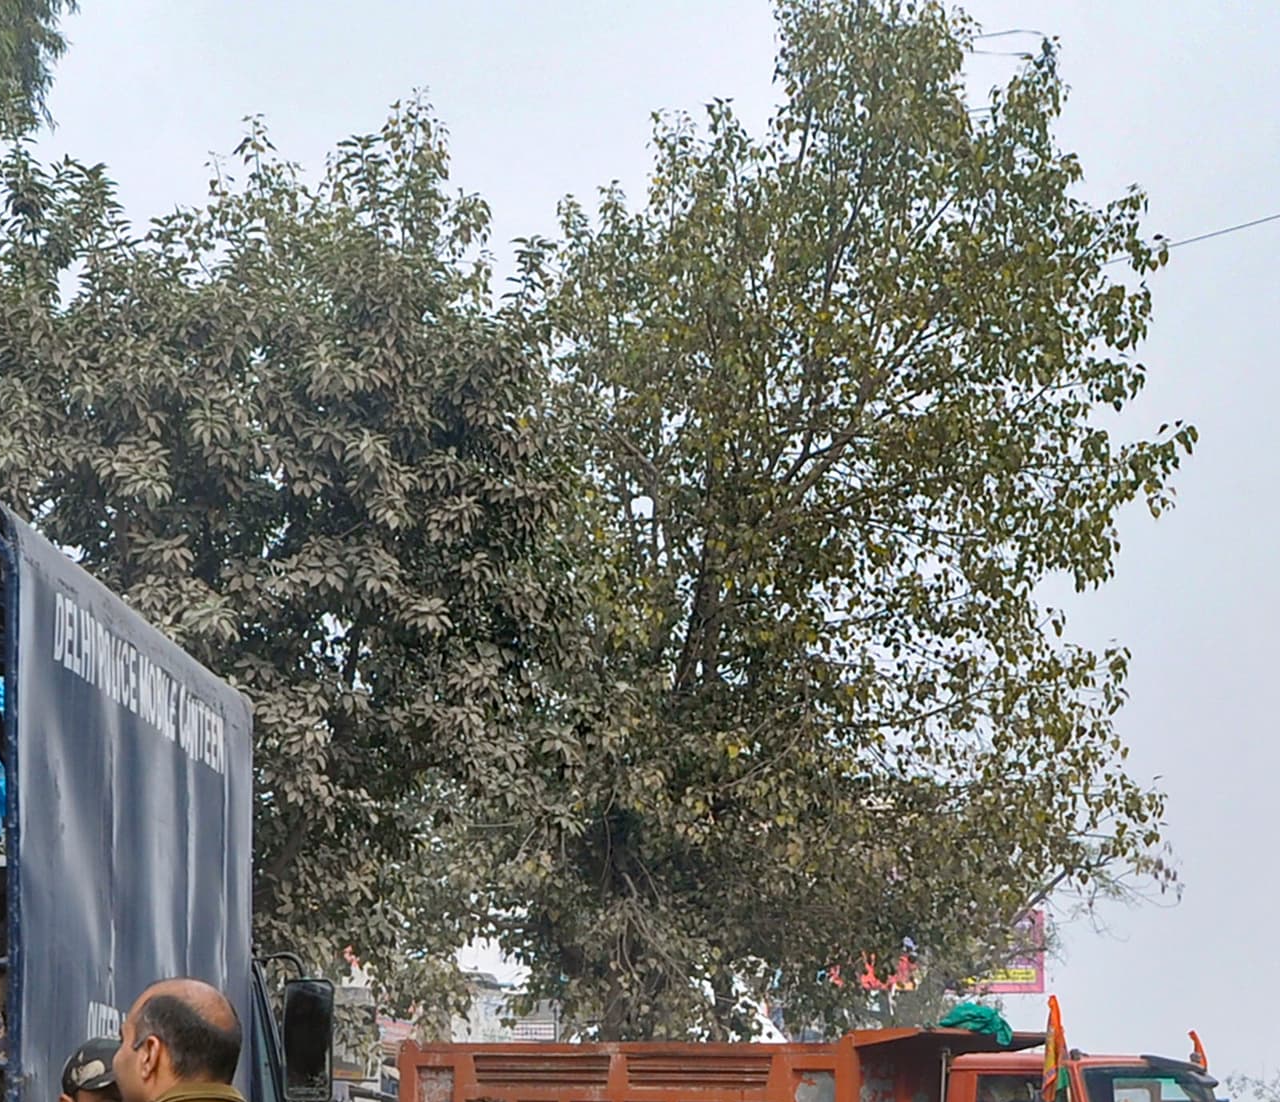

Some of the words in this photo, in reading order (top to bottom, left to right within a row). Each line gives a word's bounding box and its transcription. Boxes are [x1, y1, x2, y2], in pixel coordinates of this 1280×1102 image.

[54, 592, 95, 685] DELHI
[96, 621, 137, 714] POLICE
[139, 654, 177, 742] MOBILE
[178, 682, 225, 775] CANTEEN
